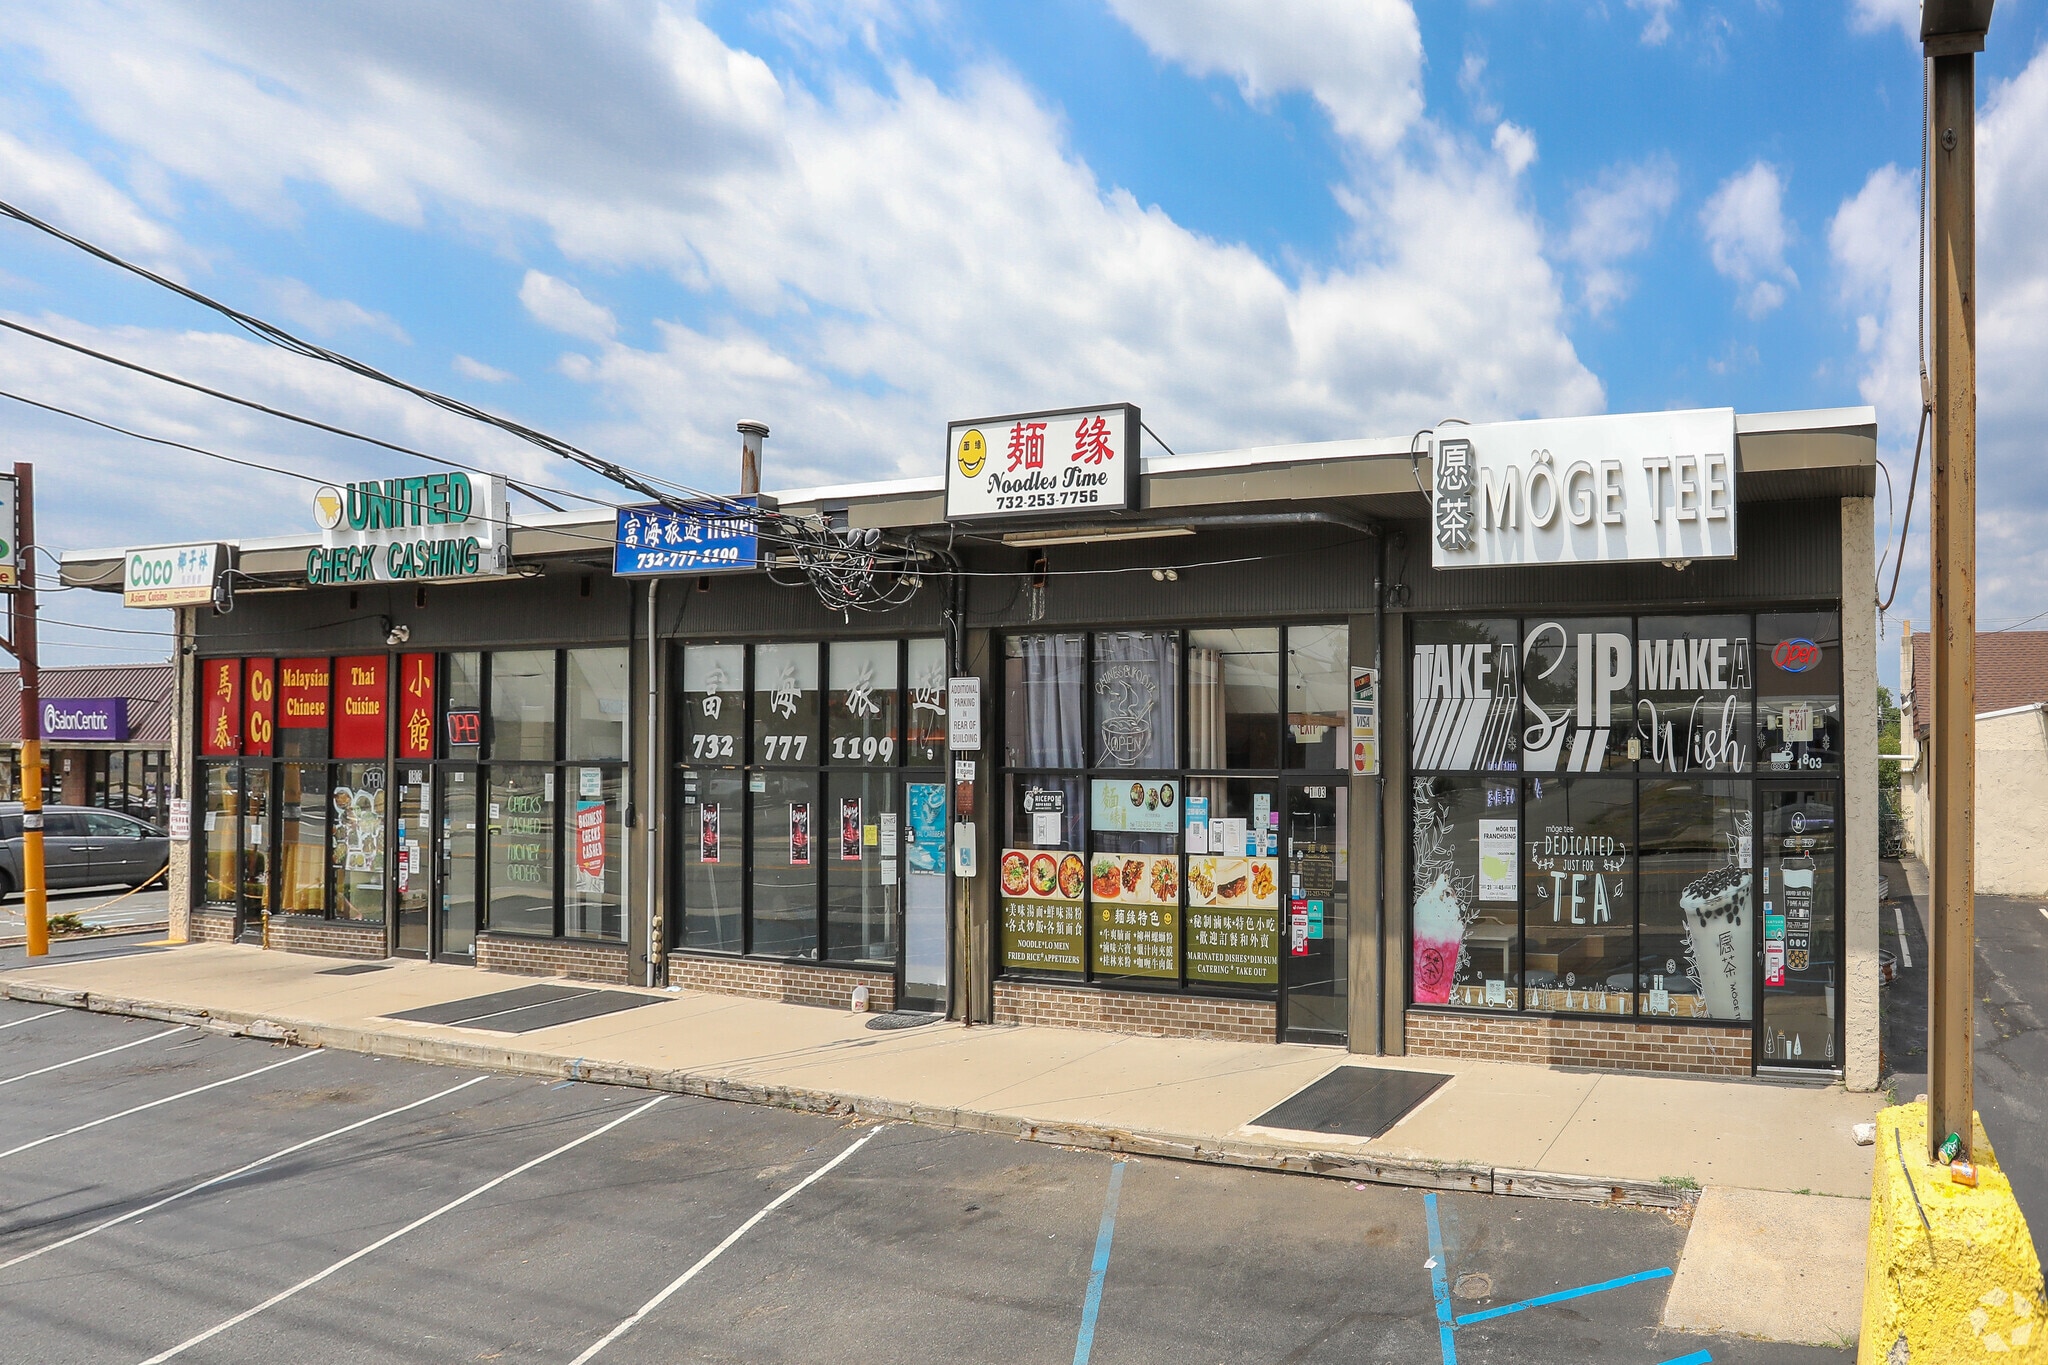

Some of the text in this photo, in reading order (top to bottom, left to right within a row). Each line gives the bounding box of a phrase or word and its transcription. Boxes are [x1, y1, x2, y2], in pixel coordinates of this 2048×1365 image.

[987, 466, 1108, 494] Noodles Time
[1480, 448, 1727, 531] MÖGE TEE
[347, 471, 473, 531] UNITED
[997, 489, 1098, 510] 732-253-7756
[1440, 442, 1469, 544] 愿茶
[306, 535, 480, 584] CHECK CASHING
[637, 547, 739, 570] 732-777-1199
[130, 554, 173, 587] Coco
[130, 592, 146, 603] Asian
[148, 591, 168, 602] Cuisine
[1638, 637, 1752, 690] MAKE A
[1773, 641, 1818, 668] Open
[283, 669, 329, 690] Malaysian
[351, 667, 375, 685] Thai
[1414, 643, 1518, 700] TAKE A
[252, 670, 272, 702] Co
[951, 684, 978, 694] ADDITIONAL
[1523, 622, 1632, 750] SIP
[214, 664, 232, 750] 馬泰
[287, 698, 325, 716] Chinese
[345, 697, 380, 715] Cuisine
[407, 659, 431, 752] 小館
[954, 698, 975, 707] PARKING
[55, 709, 108, 730] SalonCentric
[250, 712, 272, 743] Co
[954, 720, 976, 730] REAR OF
[1357, 715, 1370, 728] VISA
[952, 733, 978, 743] BUILDING
[1110, 735, 1141, 752] OPEN
[1638, 695, 1747, 773] Wish
[692, 734, 893, 762] 732 777 1199
[1797, 753, 1823, 769] 1803
[1545, 835, 1614, 856] DEDICATED
[1563, 859, 1594, 871] JUST FOR
[1550, 870, 1611, 924] TEA
[1235, 915, 1275, 932] 特色小吃
[1008, 951, 1025, 960] FRIED
[1054, 942, 1070, 950] MEIN
[1187, 951, 1223, 961] MARINATED
[1263, 956, 1278, 964] SUM
[1197, 964, 1267, 976] CATERING TAKE OUT
